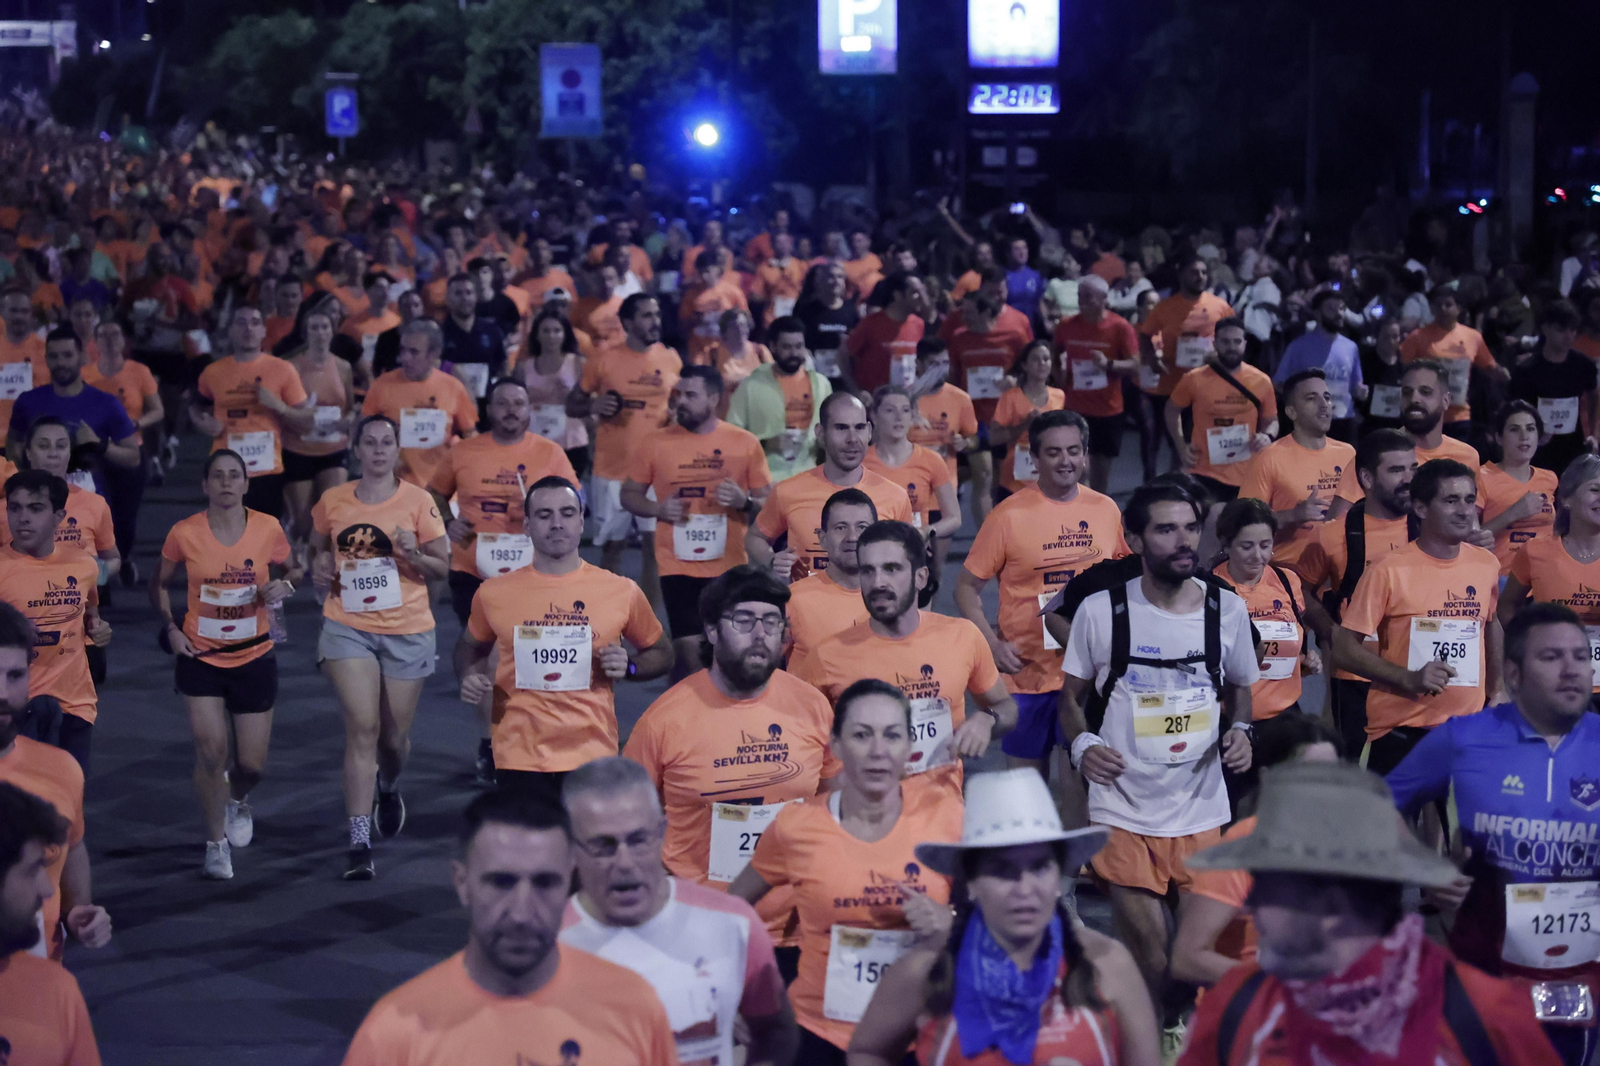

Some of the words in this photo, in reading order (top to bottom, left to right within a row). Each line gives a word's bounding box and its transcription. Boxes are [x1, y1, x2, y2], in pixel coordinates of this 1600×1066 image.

[973, 84, 1052, 107] 22:09
[1042, 541, 1074, 550] SEVILLA
[1075, 540, 1093, 548] KH7
[490, 549, 523, 560] 19837
[352, 575, 388, 590] 18598
[44, 590, 81, 599] NOCTURNA
[27, 598, 62, 608] SEVILLA
[63, 597, 81, 606] KH7
[1443, 601, 1481, 609] NOCTURNA
[215, 606, 245, 619] 1502
[543, 613, 589, 622] NOCTURNA
[1427, 609, 1460, 617] SEVILLA
[1462, 608, 1481, 617] KH7
[1137, 645, 1161, 654] HOKA
[1432, 641, 1466, 659] 7658
[531, 648, 578, 665] 19992
[915, 688, 940, 699] KH7
[1164, 715, 1191, 734] 287
[737, 743, 789, 755] NOCTURNA
[713, 755, 761, 769] SEVILLA
[763, 751, 789, 763] KH7
[1486, 836, 1600, 867] ALCONCH
[1531, 912, 1591, 935] 12173
